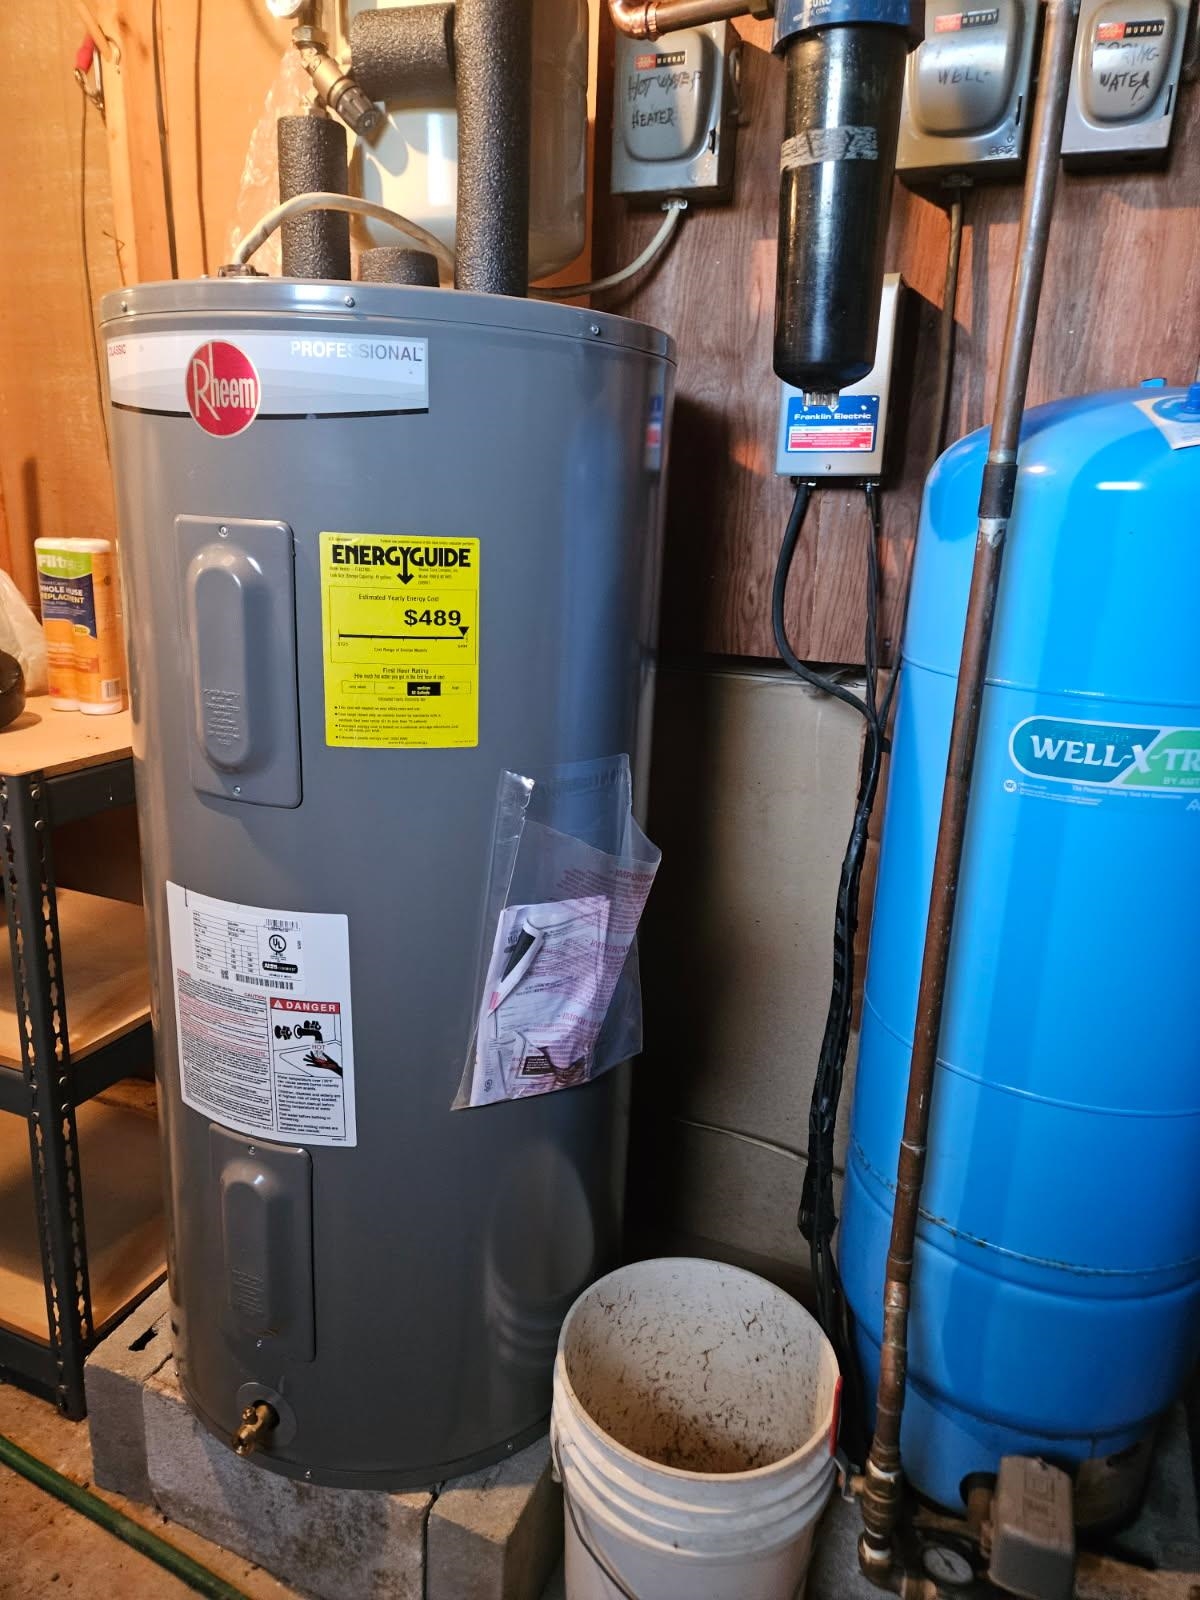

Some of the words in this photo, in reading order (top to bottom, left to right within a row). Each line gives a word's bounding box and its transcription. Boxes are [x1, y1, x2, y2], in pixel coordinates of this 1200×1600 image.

[1125, 24, 1164, 35] MURRAY
[1099, 70, 1150, 101] WATER
[632, 107, 675, 129] HEATER
[192, 342, 256, 421] Rheem
[794, 413, 832, 421] Franklin
[834, 412, 872, 420] Electric
[332, 544, 471, 571] ENERGYGUIDE
[358, 593, 386, 601] Estimated
[388, 594, 405, 603] Yearly
[406, 595, 426, 603] Energy
[404, 609, 461, 627] $489
[286, 1002, 336, 1012] DANGER
